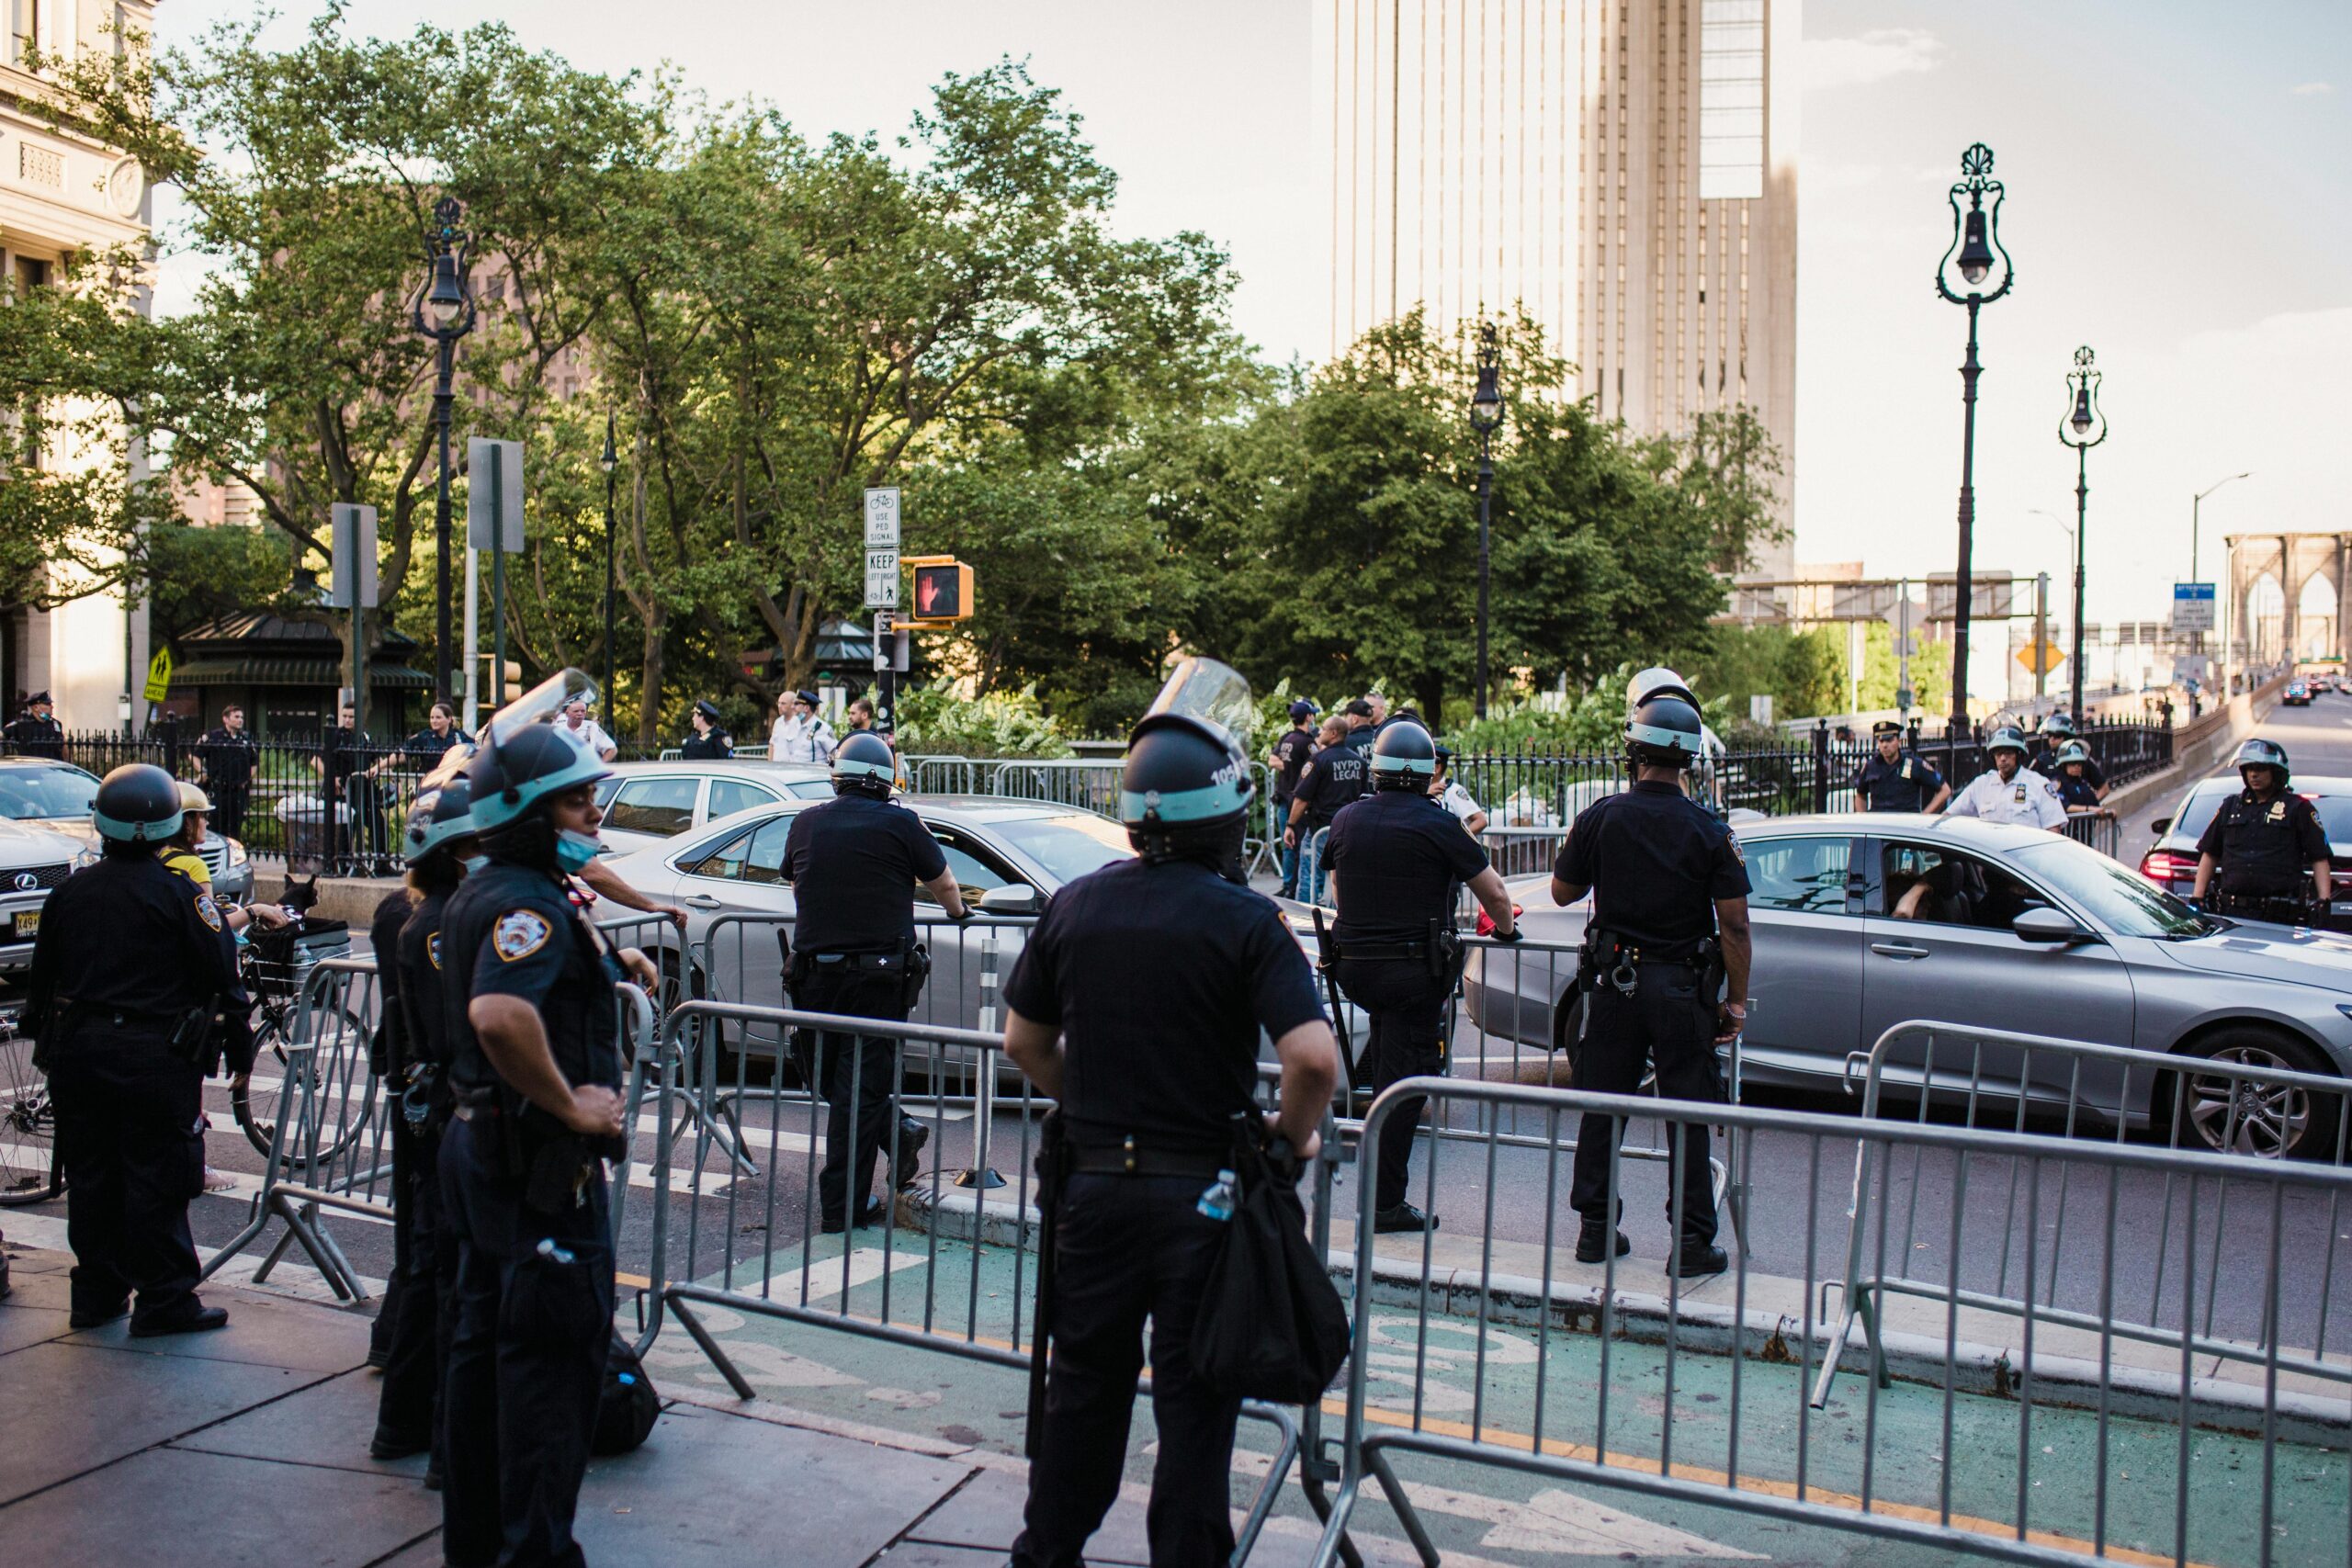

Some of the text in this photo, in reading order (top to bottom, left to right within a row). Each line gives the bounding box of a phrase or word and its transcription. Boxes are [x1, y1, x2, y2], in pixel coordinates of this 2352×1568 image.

[876, 513, 888, 521] USE
[870, 555, 894, 569] KEEP
[868, 572, 896, 581] LEFT RIGHT
[1332, 760, 1362, 772] NYPD
[1333, 770, 1361, 781] LEGAL
